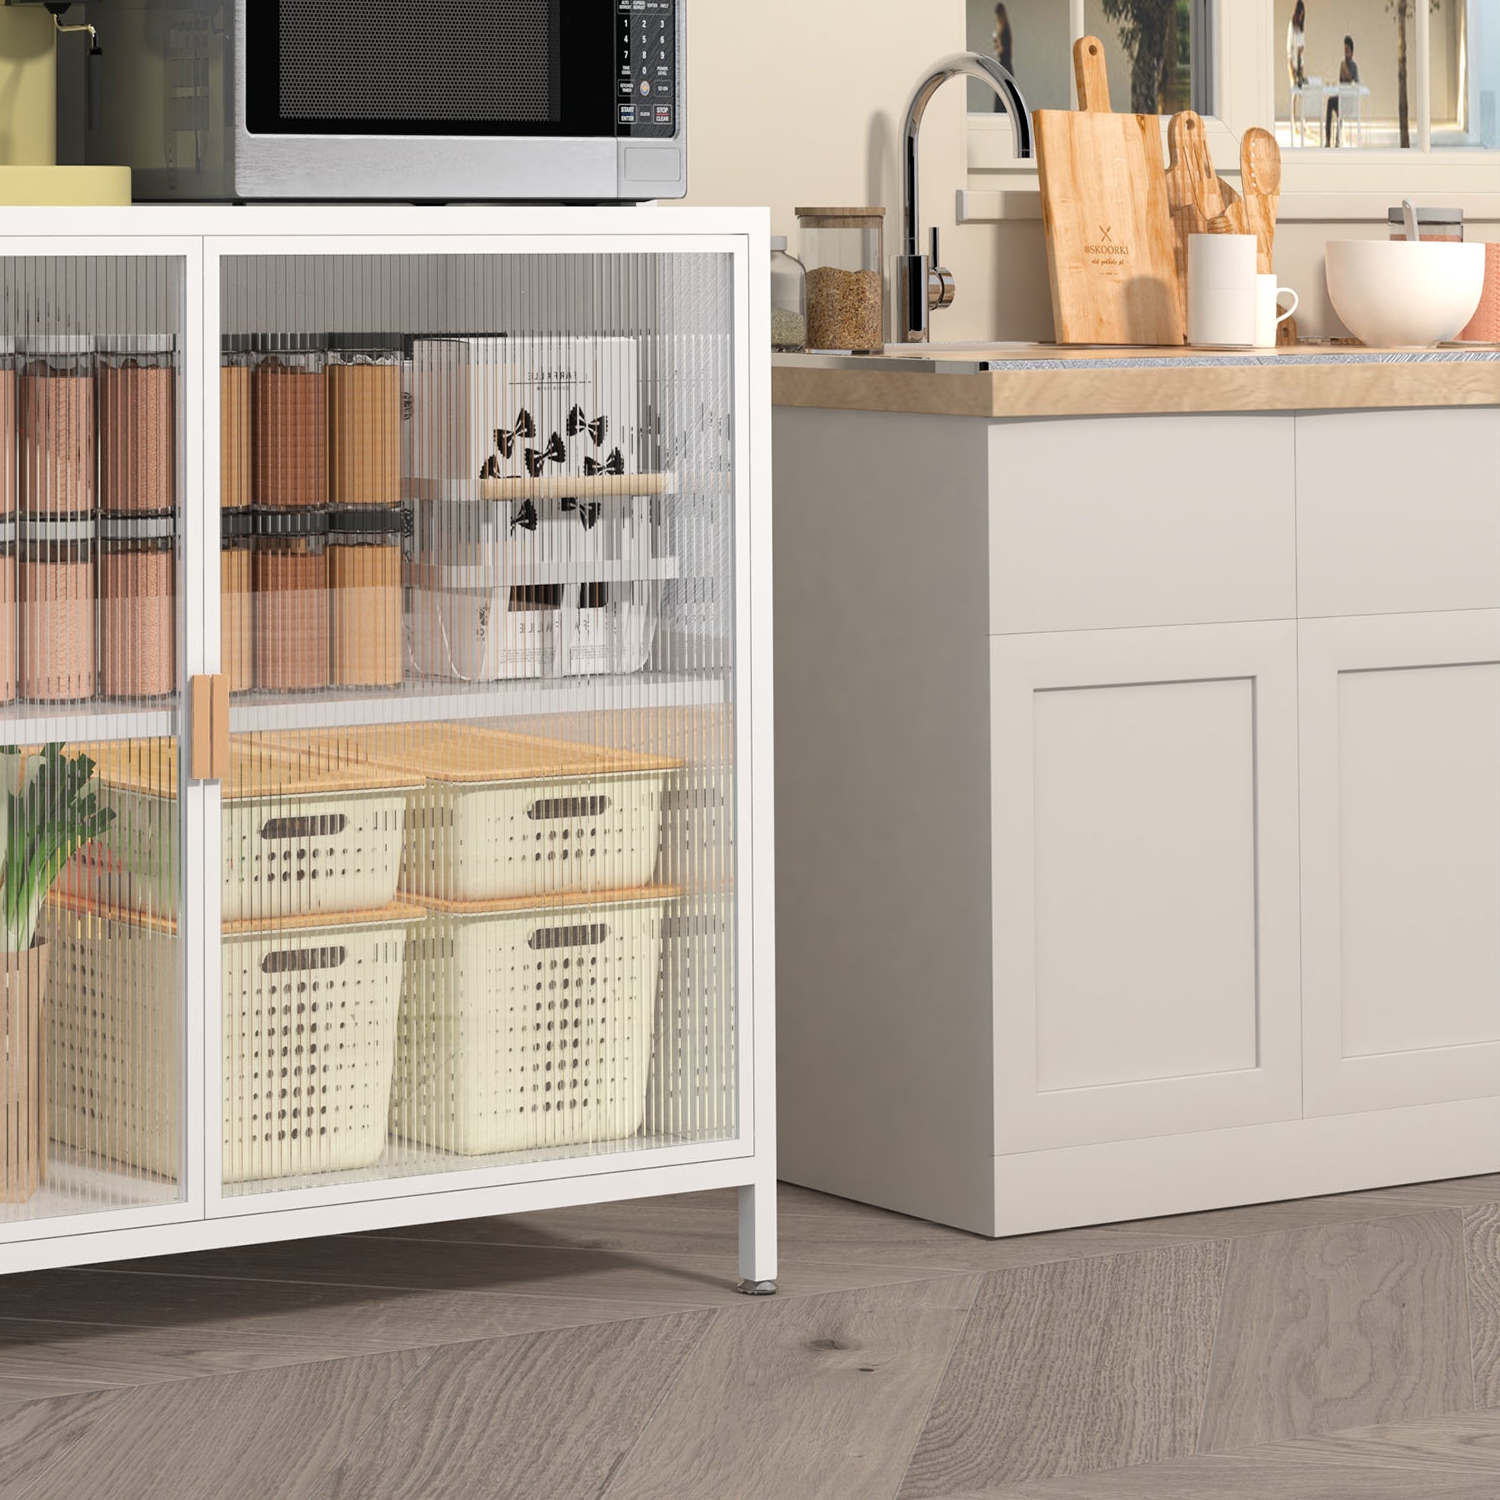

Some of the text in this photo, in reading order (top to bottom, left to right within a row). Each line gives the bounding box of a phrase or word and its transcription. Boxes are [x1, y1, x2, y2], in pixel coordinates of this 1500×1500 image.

[624, 19, 664, 28] 1 2 3
[624, 34, 664, 44] 4 5 6
[624, 50, 664, 60] 7 8 9
[642, 66, 646, 74] 0
